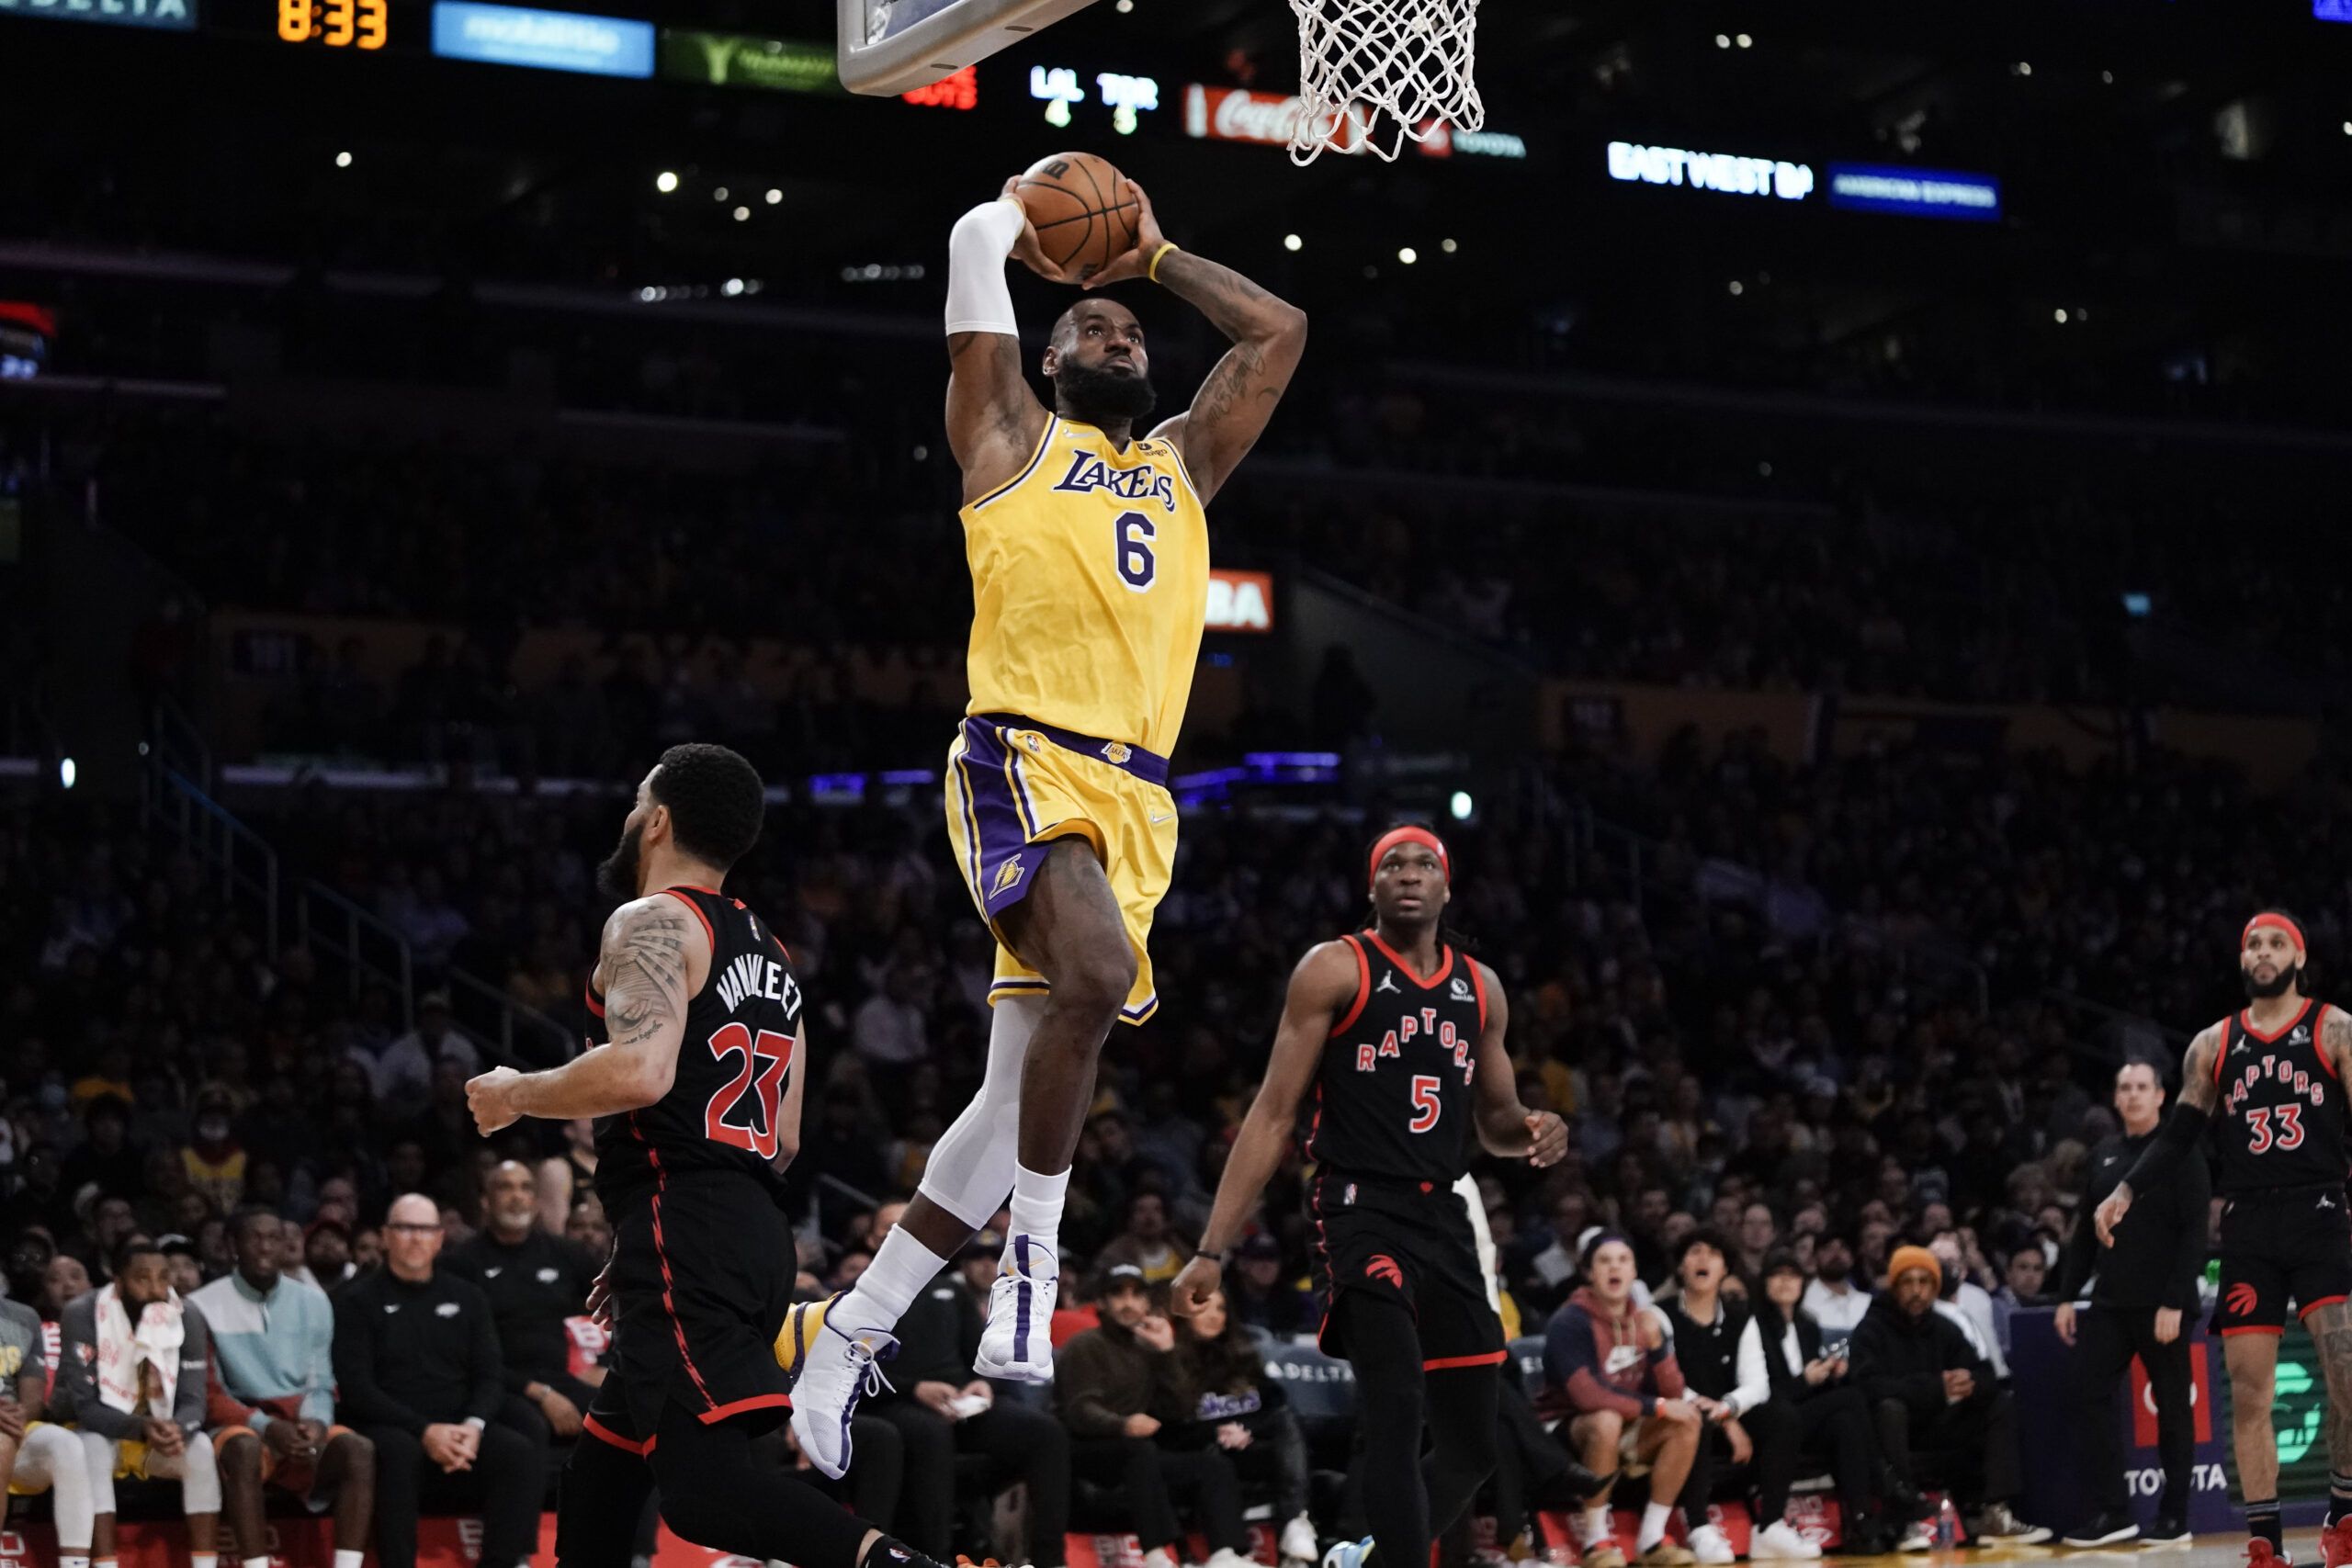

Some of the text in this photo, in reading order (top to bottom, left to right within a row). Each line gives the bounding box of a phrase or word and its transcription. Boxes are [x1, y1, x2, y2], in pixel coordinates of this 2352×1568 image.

[278, 0, 387, 50] 8:33
[1114, 511, 1158, 593] 6
[1204, 578, 1270, 629] BA
[1357, 1007, 1475, 1086] RAPTORS
[706, 1021, 796, 1160] 23
[1409, 1075, 1442, 1134] 5
[2224, 1055, 2324, 1116] RAPTORS
[2246, 1102, 2305, 1155] 33
[2124, 1464, 2228, 1497] TOTA
